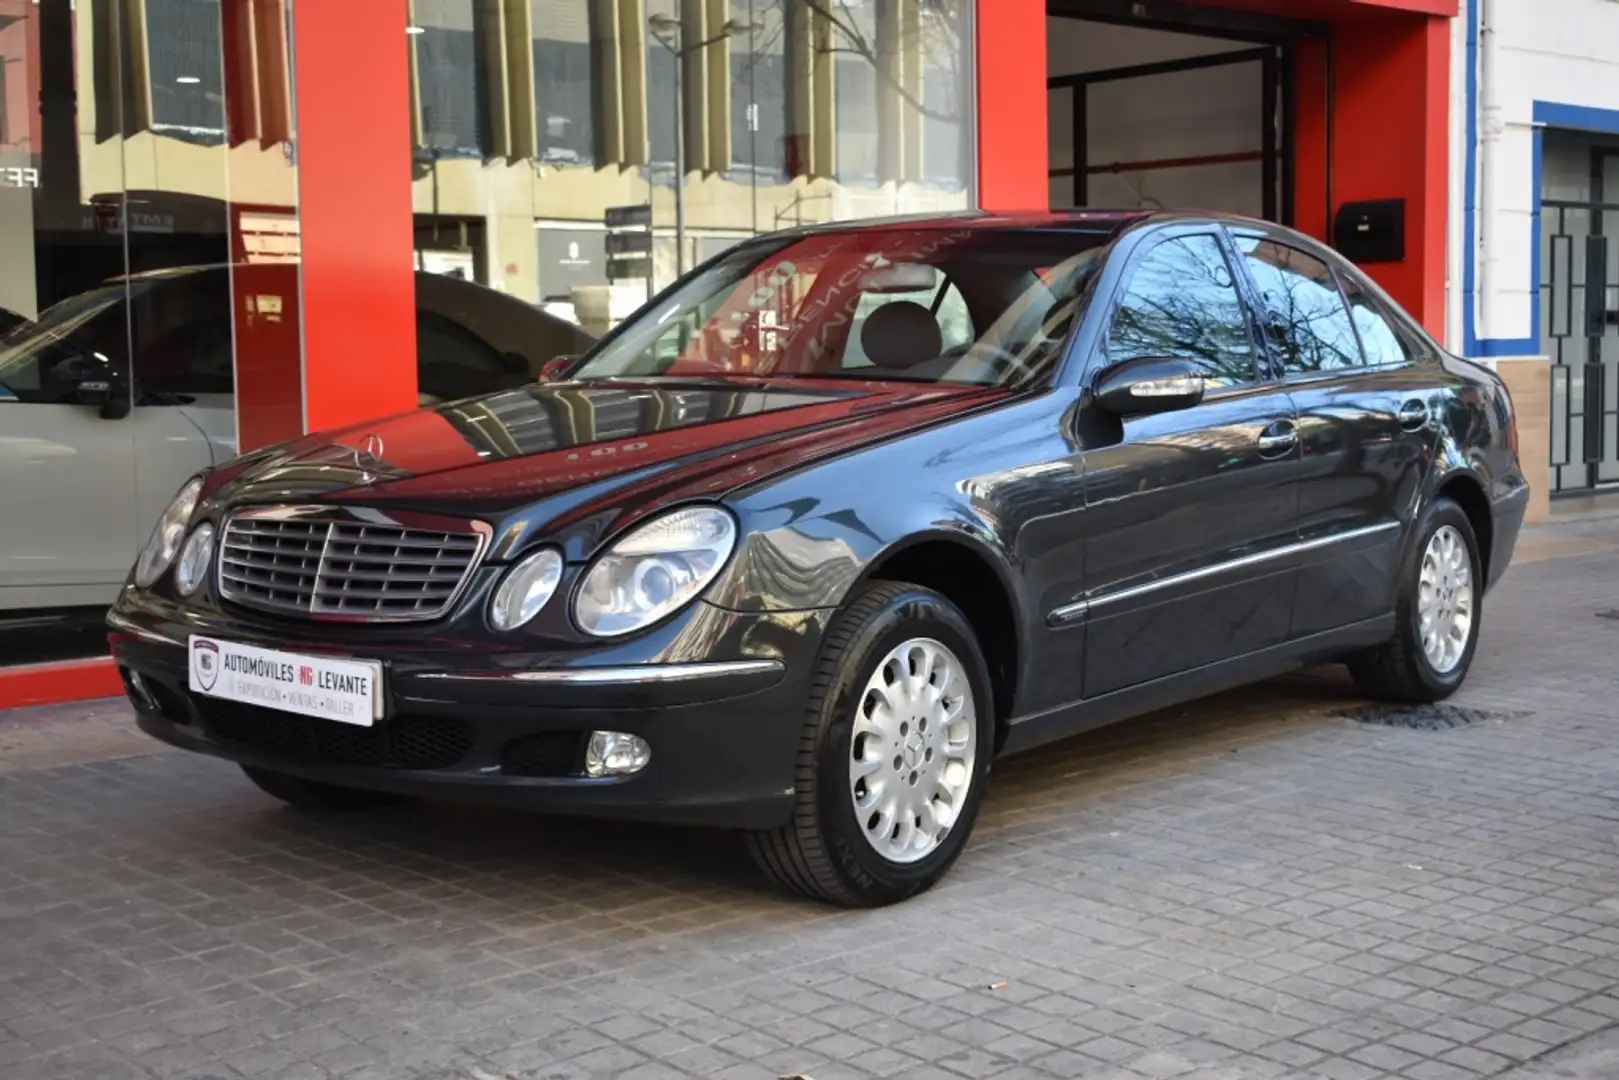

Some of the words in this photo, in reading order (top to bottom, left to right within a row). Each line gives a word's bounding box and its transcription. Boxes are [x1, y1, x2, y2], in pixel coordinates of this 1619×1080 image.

[224, 653, 294, 683] AUTOMÓVILES
[299, 665, 313, 686] NG
[318, 670, 368, 696] LEVANTE
[288, 690, 318, 709] VENTAS
[325, 699, 354, 717] TALLER
